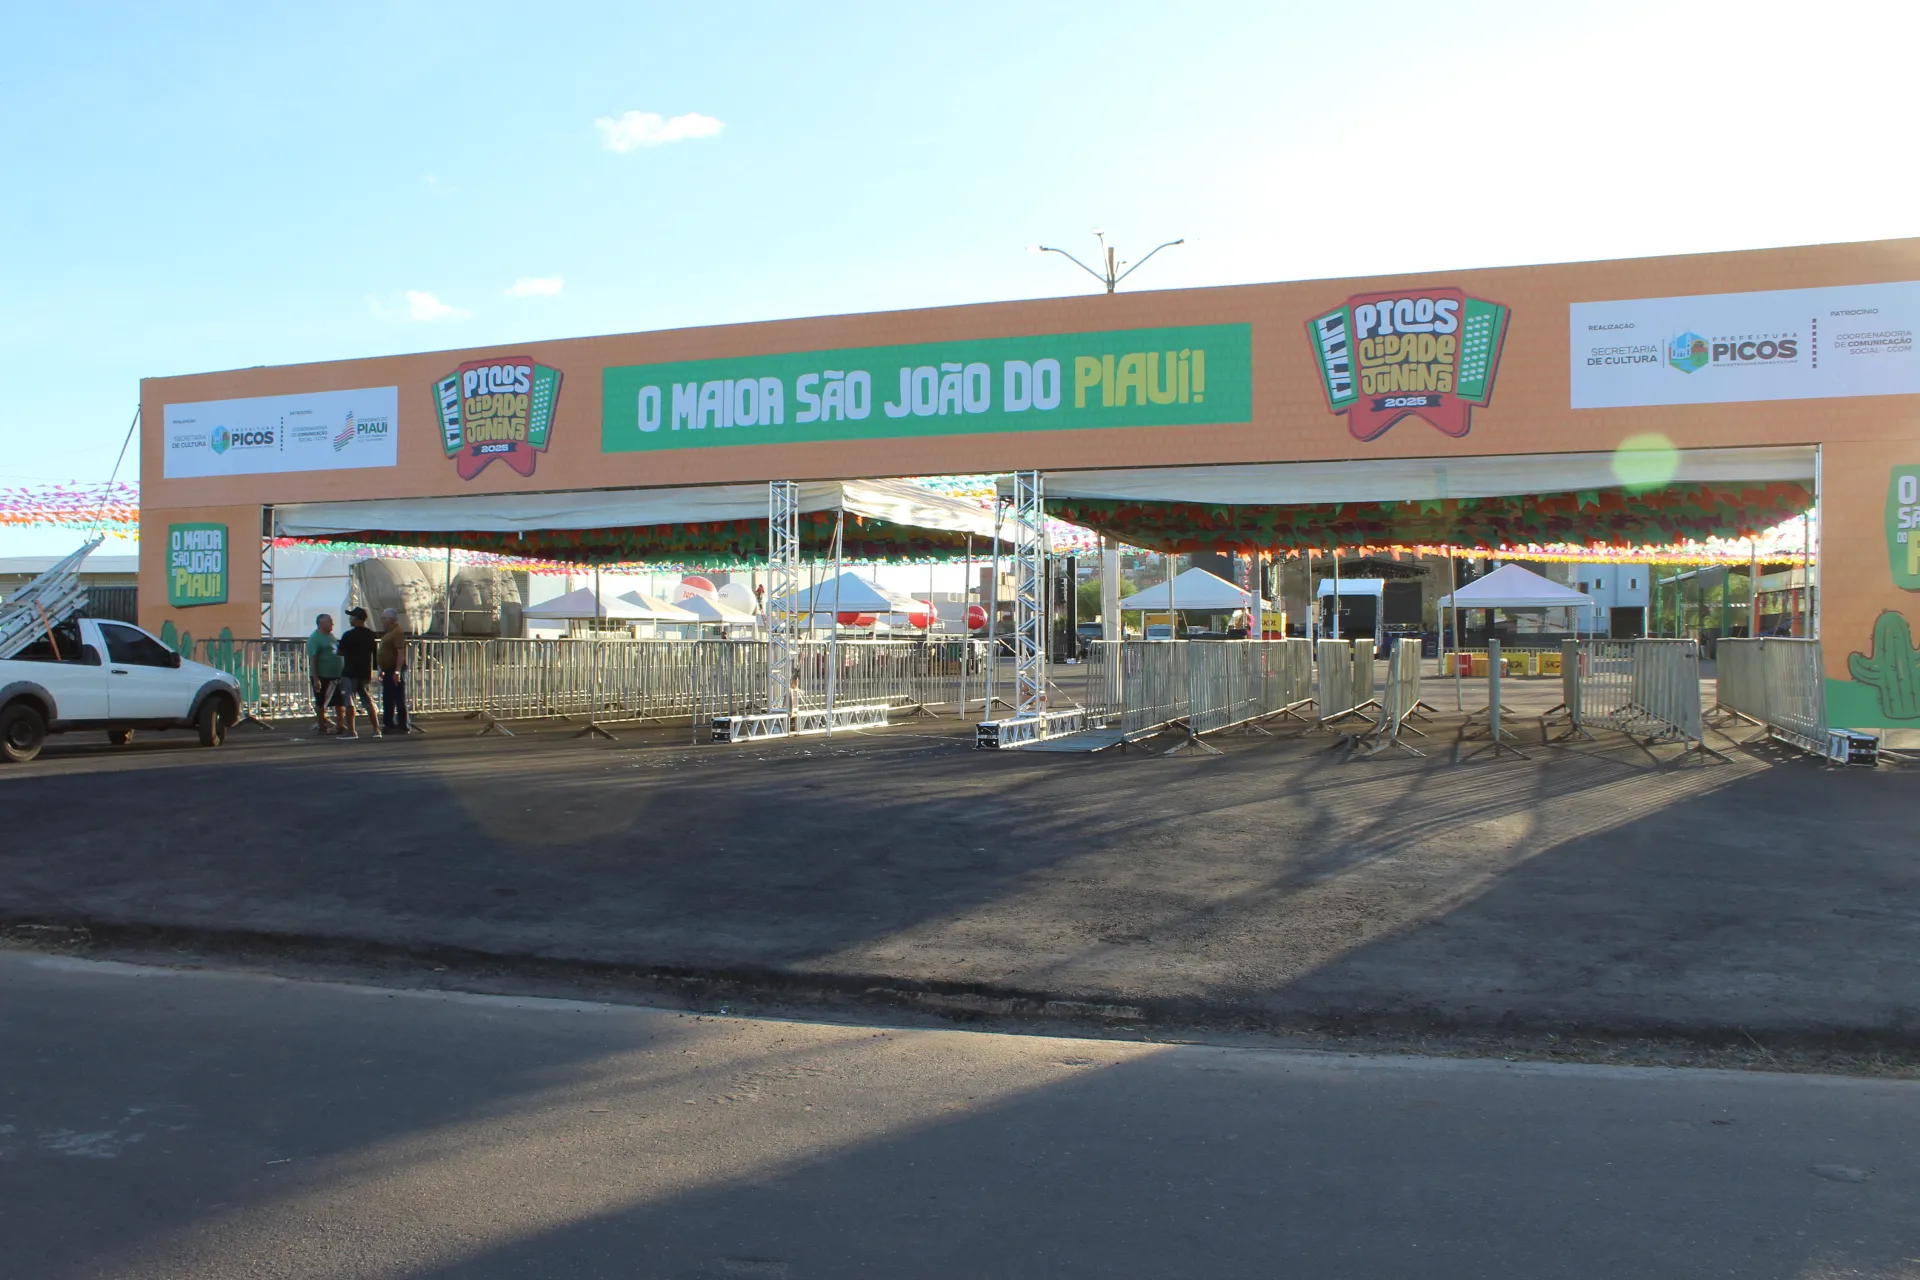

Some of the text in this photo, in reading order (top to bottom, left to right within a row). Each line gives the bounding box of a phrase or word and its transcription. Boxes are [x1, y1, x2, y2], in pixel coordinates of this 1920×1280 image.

[1354, 298, 1459, 339] PICOS
[1712, 332, 1798, 342] PREFEITURA
[1836, 330, 1912, 340] COORDENADORIA
[1847, 336, 1912, 347] COMUNICAÇÃO
[1591, 345, 1658, 356] SECRETARIA
[1712, 339, 1798, 361] PICOS
[1849, 347, 1880, 355] SOCIAL
[1587, 354, 1658, 366] DE CULTURA
[463, 365, 531, 398] PICOS
[638, 348, 1205, 432] O MAIOR SÃO JOÃO DO PIAUÍ!
[1384, 396, 1427, 407] 2025
[231, 431, 274, 446] PICOS
[481, 444, 509, 453] 2025
[1898, 475, 1917, 504] O
[1898, 506, 1920, 529] SÃ
[172, 530, 222, 550] O MAIOR
[172, 551, 190, 567] SÃO
[187, 550, 222, 573] JOÃO
